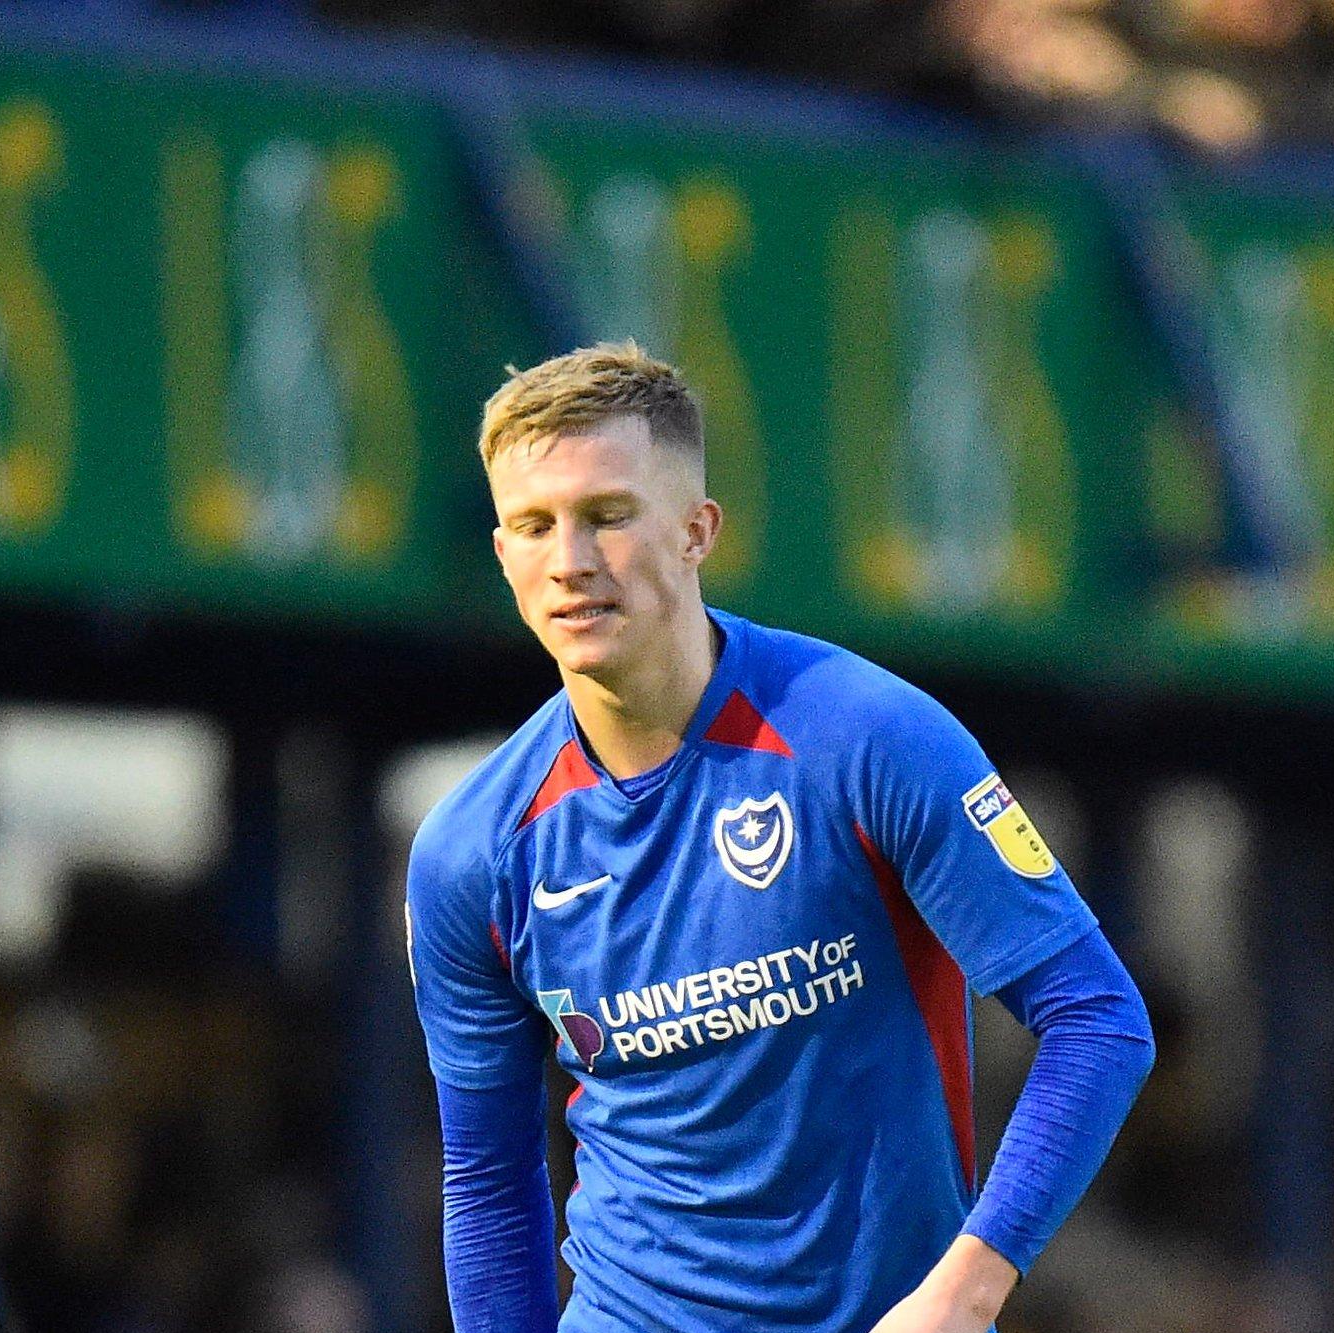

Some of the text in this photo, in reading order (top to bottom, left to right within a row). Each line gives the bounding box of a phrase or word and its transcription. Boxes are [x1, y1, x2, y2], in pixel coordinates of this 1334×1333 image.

[599, 932, 857, 1028] UNIVERSITY OF
[611, 960, 865, 1062] PORTSMOUTH
